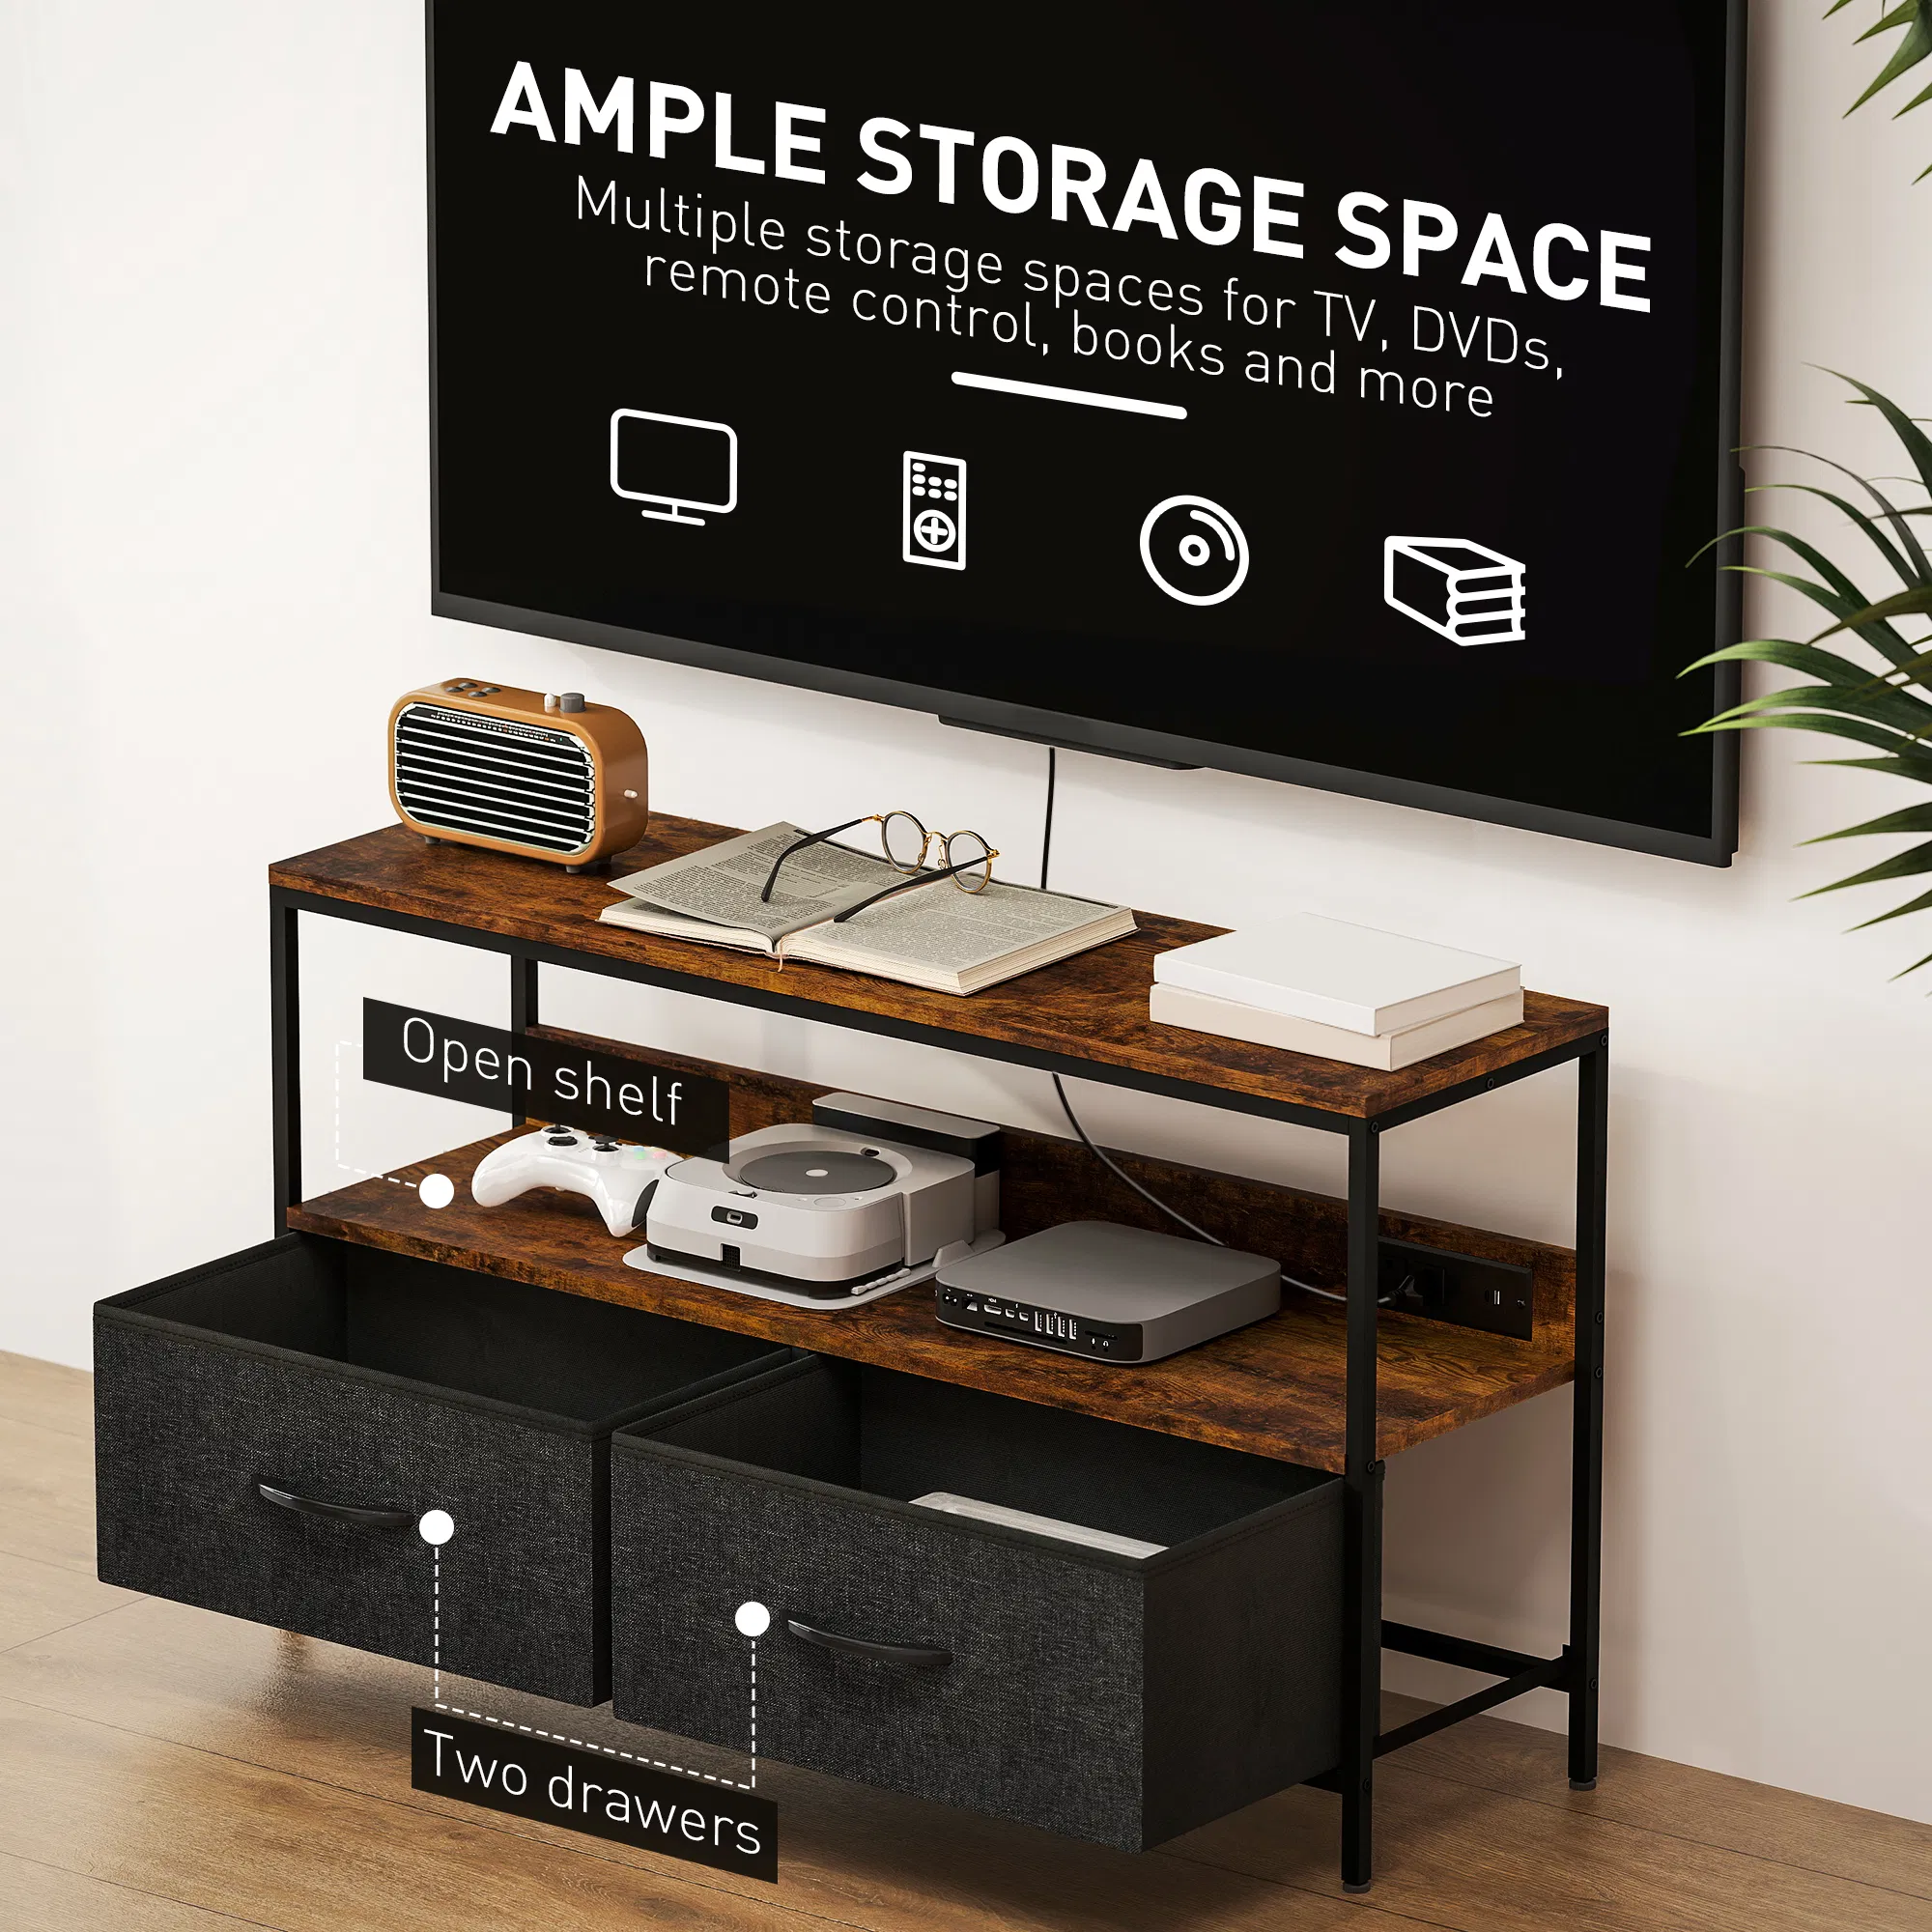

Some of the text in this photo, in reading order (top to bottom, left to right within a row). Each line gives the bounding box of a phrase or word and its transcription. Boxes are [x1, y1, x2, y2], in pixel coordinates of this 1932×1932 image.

[490, 61, 1650, 313] AMPLE STORAGE SPACE
[577, 174, 1563, 381] Multiple storage spaces for TV, DVDs,
[646, 255, 1493, 418] remote control, books and more
